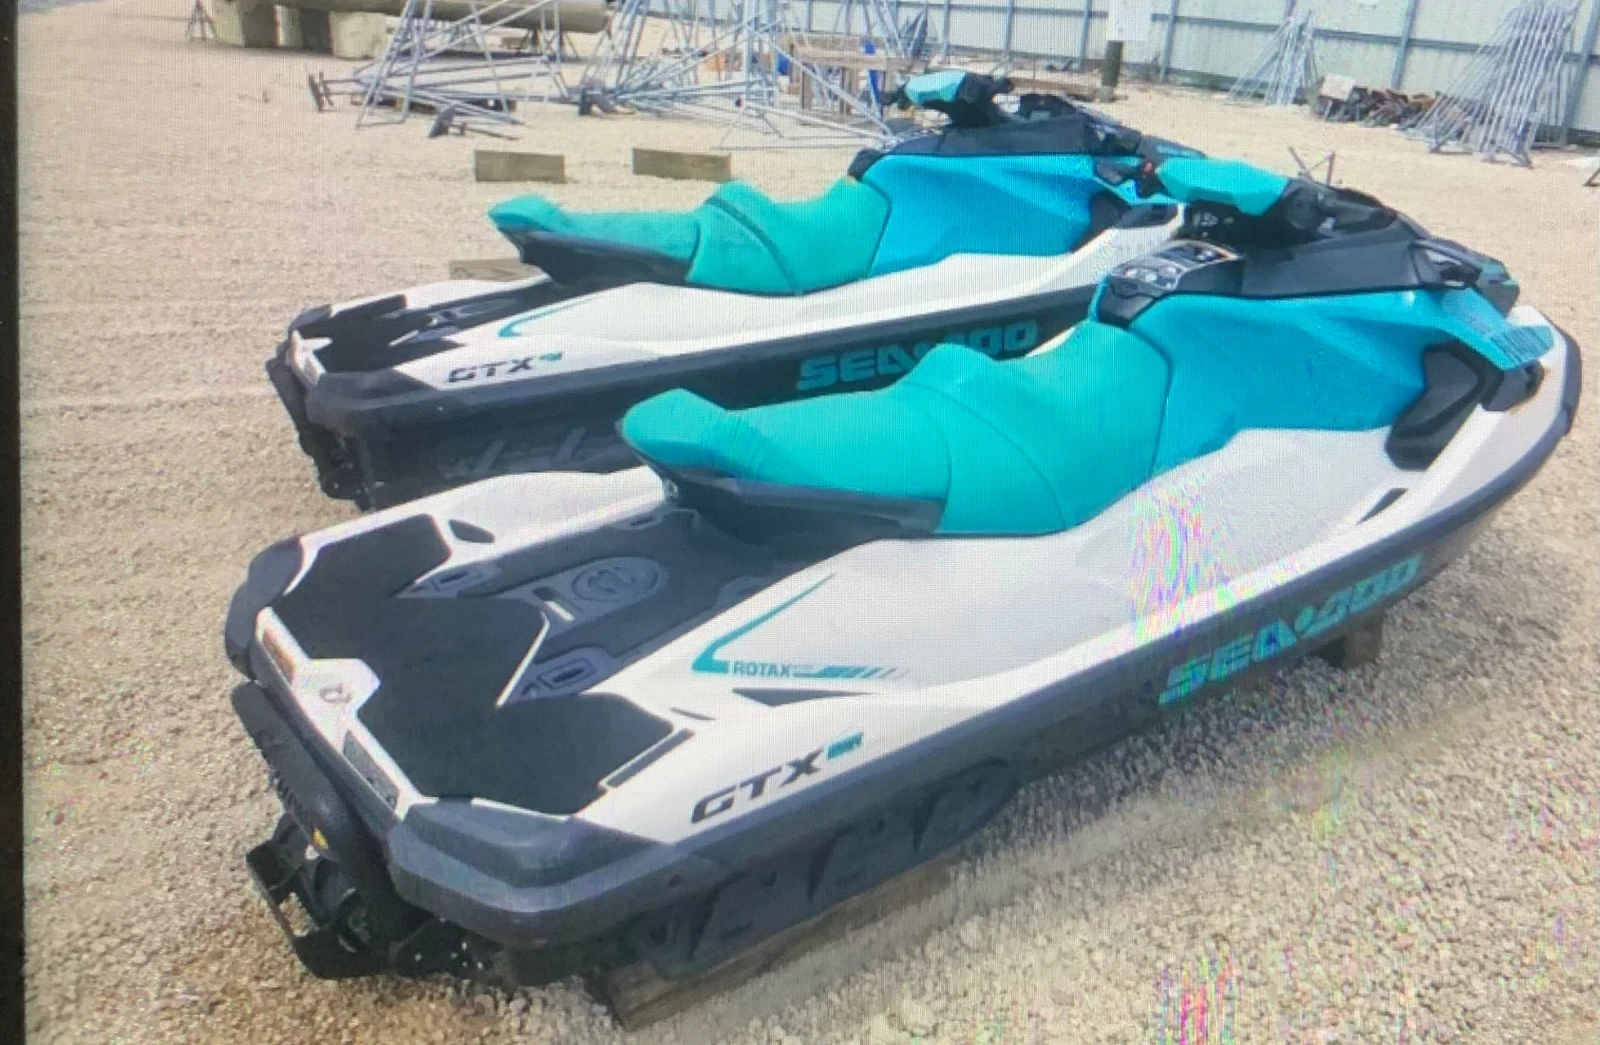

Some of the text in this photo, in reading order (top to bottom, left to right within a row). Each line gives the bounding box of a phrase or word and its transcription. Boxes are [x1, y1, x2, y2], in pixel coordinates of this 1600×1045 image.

[447, 357, 533, 383] GTX
[733, 660, 791, 678] ROTAX
[691, 748, 825, 824] GTX
